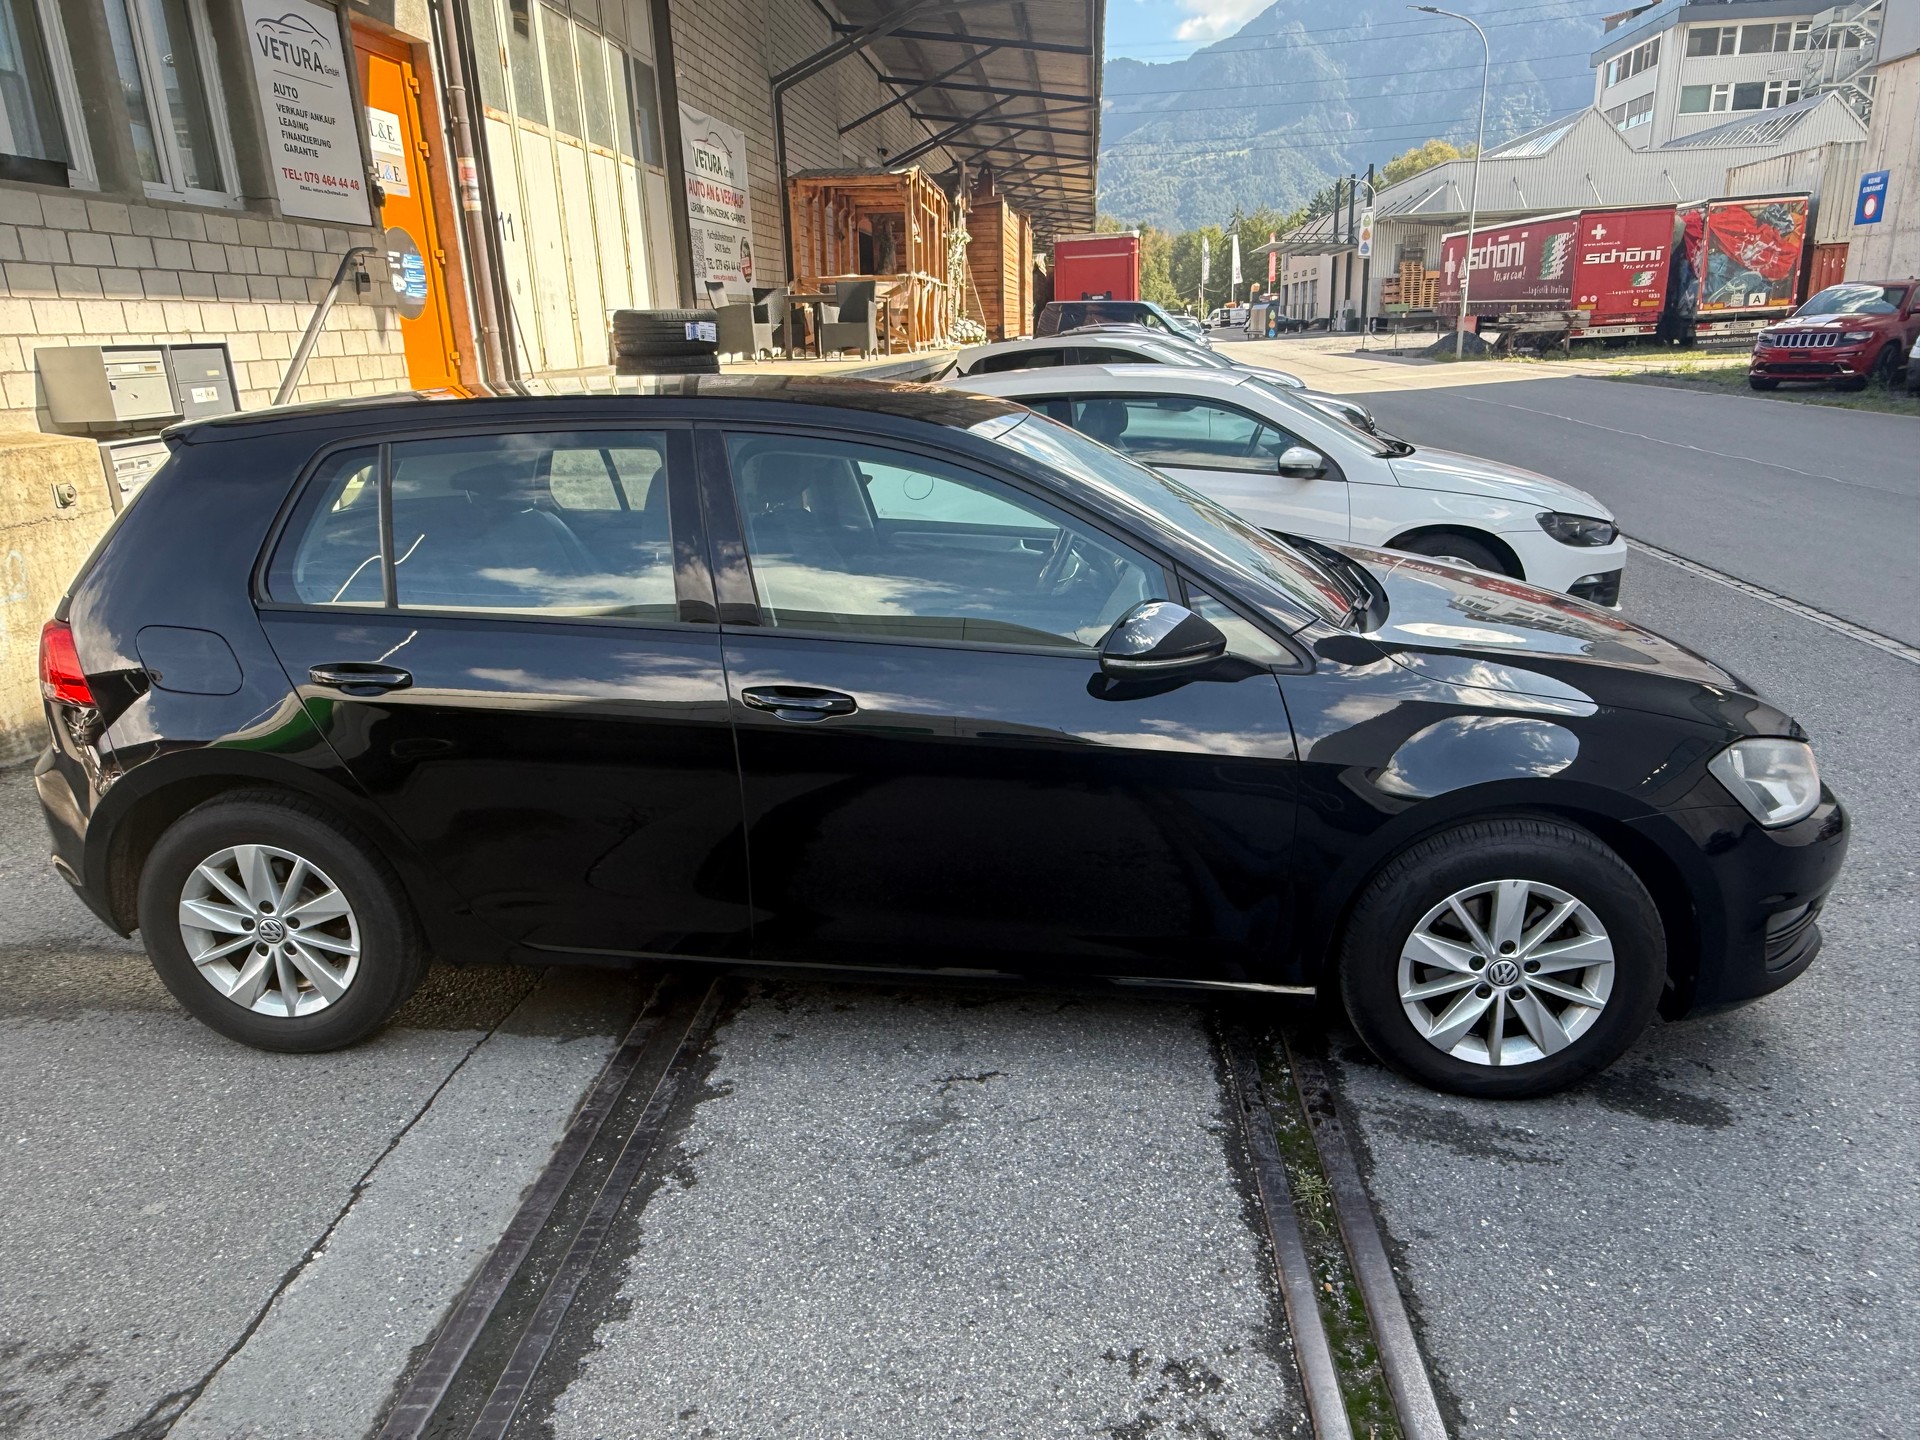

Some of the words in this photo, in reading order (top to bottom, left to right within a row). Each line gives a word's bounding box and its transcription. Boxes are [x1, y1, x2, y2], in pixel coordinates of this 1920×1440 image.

[256, 32, 325, 75] VETURA
[273, 82, 299, 99] AUTO
[276, 103, 309, 119] VERKAUF
[310, 112, 336, 126] ANKAUF
[279, 117, 309, 132] LEASING
[281, 130, 332, 149] FINANZIERUNG
[284, 143, 320, 158] GARANTIE
[692, 146, 723, 176] VETURA
[281, 167, 302, 182] TEL:
[304, 171, 320, 185] 079
[322, 174, 337, 187] 464
[338, 177, 349, 189] 44
[350, 179, 360, 191] 48
[688, 178, 706, 198] AUTO
[706, 183, 715, 202] AN
[498, 211, 515, 242] 11
[1753, 294, 1761, 304] A
